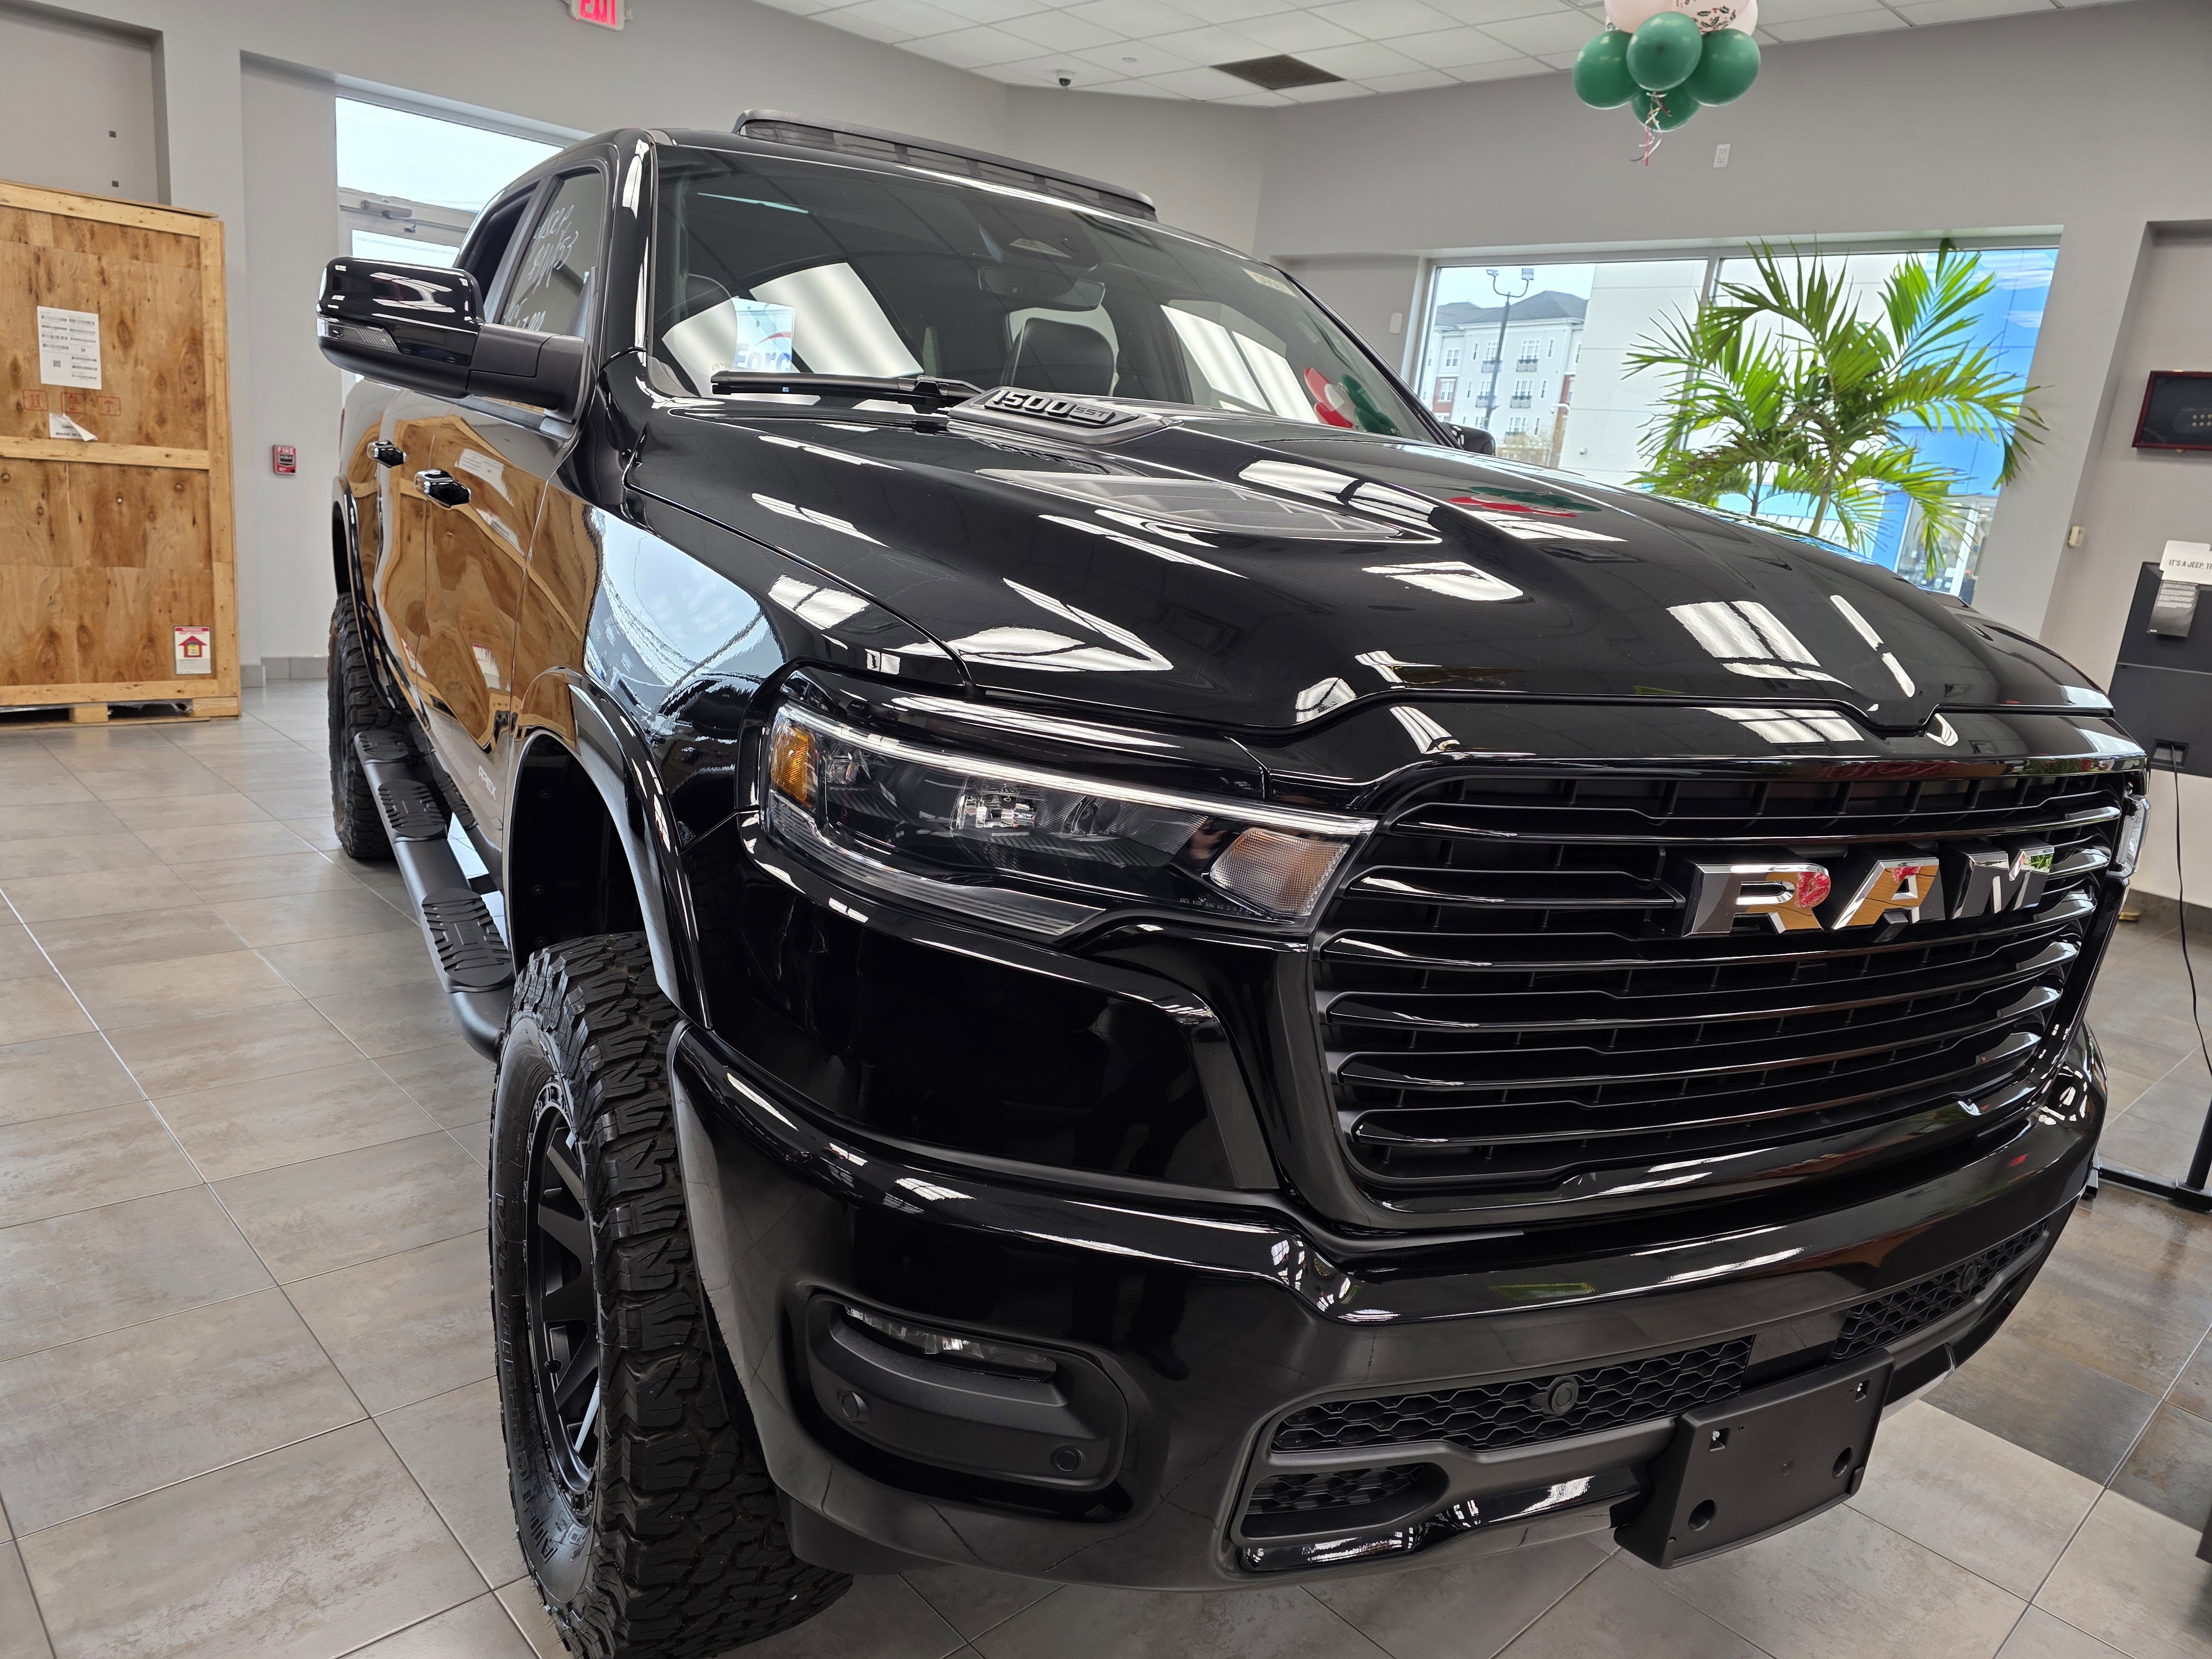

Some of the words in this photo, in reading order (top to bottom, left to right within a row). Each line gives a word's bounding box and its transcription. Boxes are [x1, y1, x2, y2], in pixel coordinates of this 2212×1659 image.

[992, 389, 1077, 418] 1500
[1073, 406, 1109, 418] SST
[2168, 559, 2181, 567] IT'S
[478, 765, 497, 801] APEX
[1682, 846, 2055, 937] RAM
